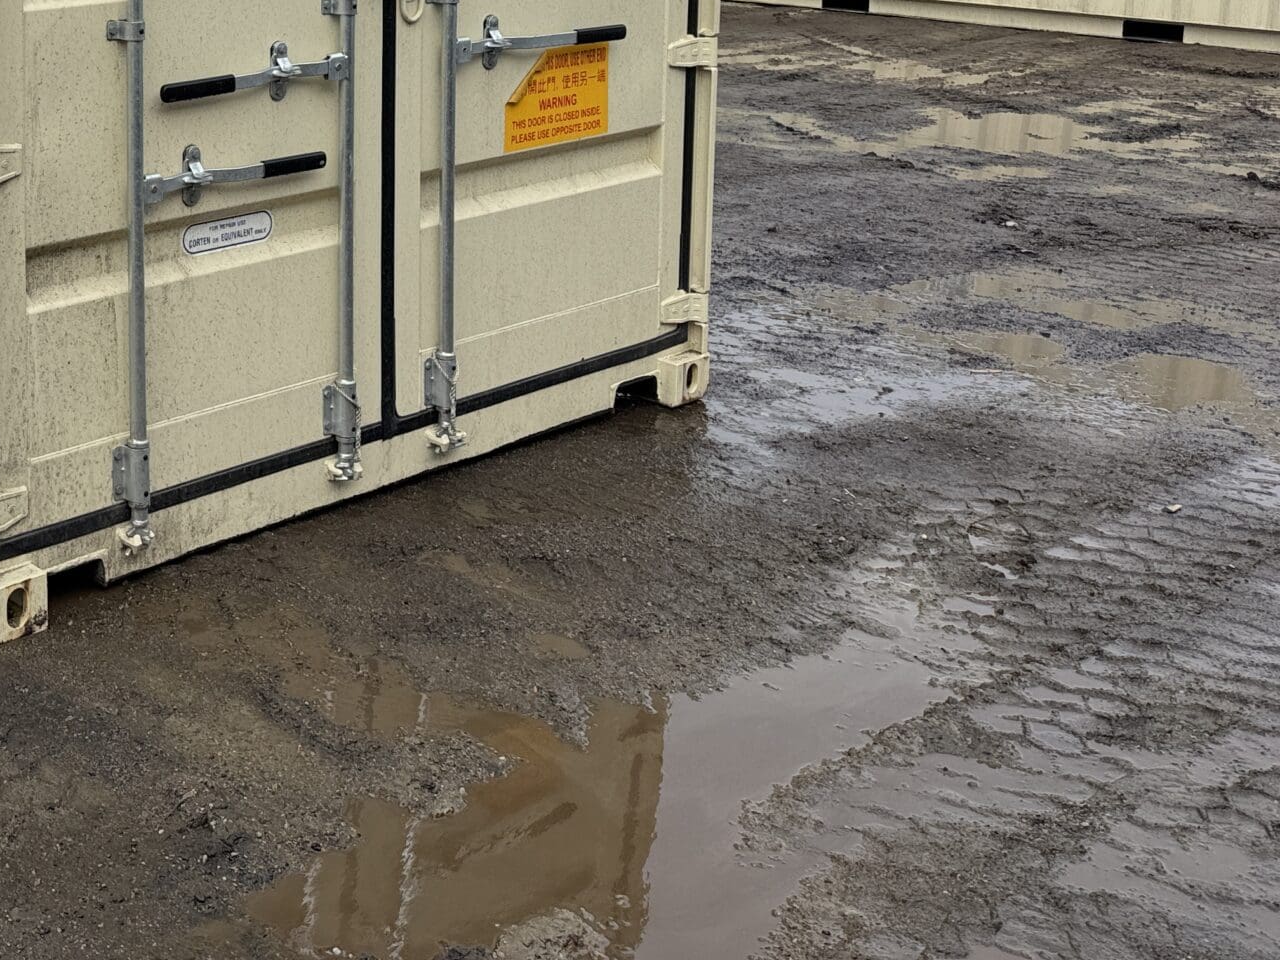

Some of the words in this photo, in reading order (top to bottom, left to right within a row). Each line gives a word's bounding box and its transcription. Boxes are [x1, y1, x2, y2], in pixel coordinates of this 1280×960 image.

[581, 48, 596, 65] OTHER
[597, 46, 607, 62] END
[539, 94, 577, 111] WARNING
[512, 120, 526, 131] THIS
[528, 116, 546, 128] DOOR
[548, 114, 553, 124] IS
[554, 110, 580, 123] CLOSED
[511, 131, 536, 144] PLEASE
[538, 128, 550, 140] USE
[551, 124, 581, 137] OPPOSITE
[189, 237, 210, 249] CORTEN
[221, 228, 253, 242] EQUIVALENT
